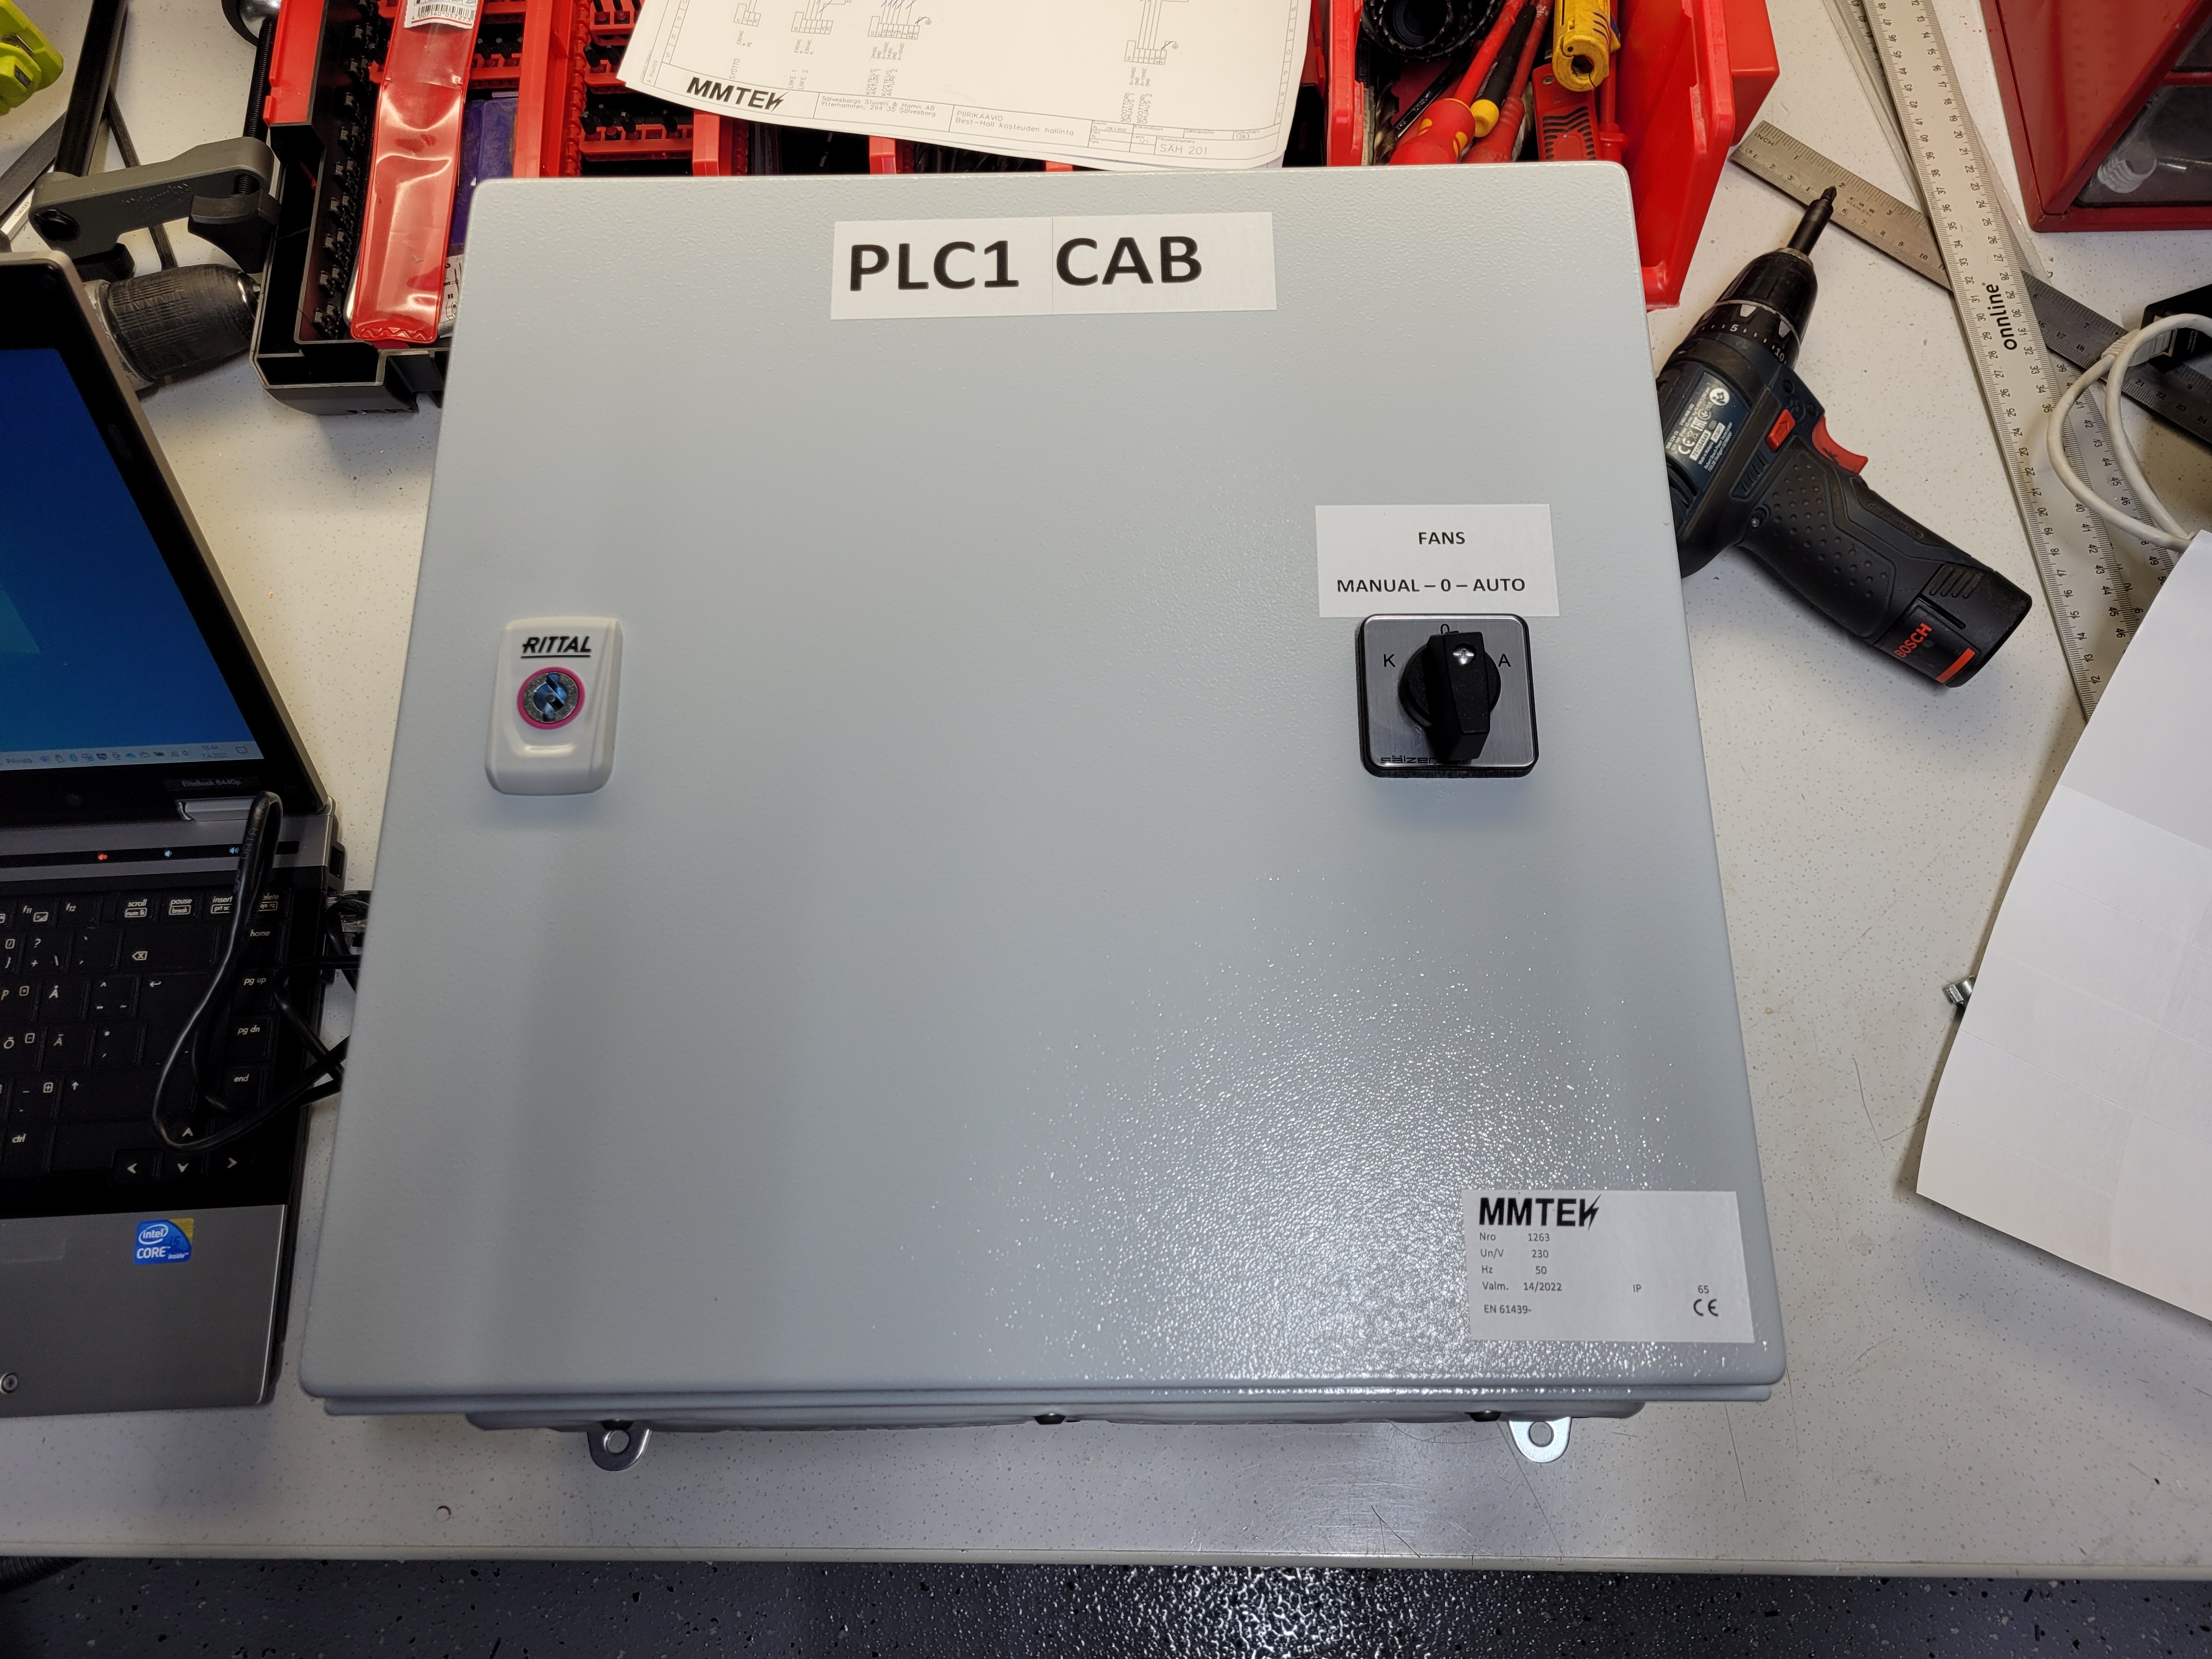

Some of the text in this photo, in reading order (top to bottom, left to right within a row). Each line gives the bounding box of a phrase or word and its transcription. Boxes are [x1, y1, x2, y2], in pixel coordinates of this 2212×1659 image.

[445, 13, 471, 22] 057273
[788, 76, 796, 89] LIIKE
[798, 76, 806, 90] LIIKE
[865, 69, 876, 95] KOSTEUS
[871, 75, 880, 95] ANTURI
[882, 70, 892, 96] KOSTEUS
[887, 76, 896, 97] ANTURI
[686, 77, 788, 112] MMTEK
[822, 96, 861, 104] Sölvesborgs
[900, 108, 936, 117] Sölvesborg
[1120, 93, 1130, 122] MOOTTORI
[1125, 99, 1135, 122] OHJAUS
[1136, 94, 1146, 123] MOOTTORI
[1142, 100, 1150, 124] OHJAUS
[957, 111, 1003, 121] PIIRIKAAVIO
[999, 122, 1040, 132] kosteuden
[1045, 127, 1074, 136] hallinta
[1954, 130, 1963, 139] 20
[1754, 133, 1775, 146] INCH
[1920, 134, 1929, 143] 40
[1160, 143, 1207, 155] SÄH 201
[1970, 182, 1980, 191] 23
[1942, 204, 1952, 212] 36
[850, 236, 1202, 292] PLC1 CAB
[1999, 272, 2010, 280] 28
[1976, 313, 1986, 322] 30
[1986, 284, 2017, 350] onnline
[1774, 348, 1785, 362] 10
[2057, 363, 2067, 373] 39
[2135, 379, 2145, 387] 21
[2006, 408, 2017, 417] 25
[2120, 496, 2130, 506] 46
[2037, 507, 2048, 517] 20
[1418, 532, 1466, 545] FANS
[2088, 544, 2098, 554] 42
[1337, 579, 1420, 592] MANUAL
[1441, 579, 1451, 592] 0
[1473, 578, 1525, 591] AUTO
[2109, 607, 2119, 617] 45
[522, 636, 591, 653] RITTAL
[1894, 623, 1932, 658] BOSCH
[1383, 654, 1396, 668] K
[1498, 653, 1511, 667] A
[2091, 675, 2101, 684] 12
[66, 903, 76, 912] f12
[128, 899, 148, 907] scroll
[170, 898, 193, 907] pause
[250, 929, 270, 938] home
[1, 990, 9, 1001] P
[49, 985, 59, 999] Å
[250, 1025, 261, 1033] dn
[234, 1074, 250, 1082] end
[12, 1133, 26, 1143] ctrl
[1479, 1194, 1601, 1231] MMTEK
[143, 1228, 165, 1239] intel
[1479, 1232, 1550, 1242] Nro 1263
[136, 1246, 166, 1259] CORE
[1480, 1248, 1549, 1259] Un/V 230
[1481, 1265, 1547, 1274] Hz 50
[1482, 1281, 1709, 1294] Valm. 14/2022 IP 65
[1484, 1304, 1532, 1314] EN 61439-
